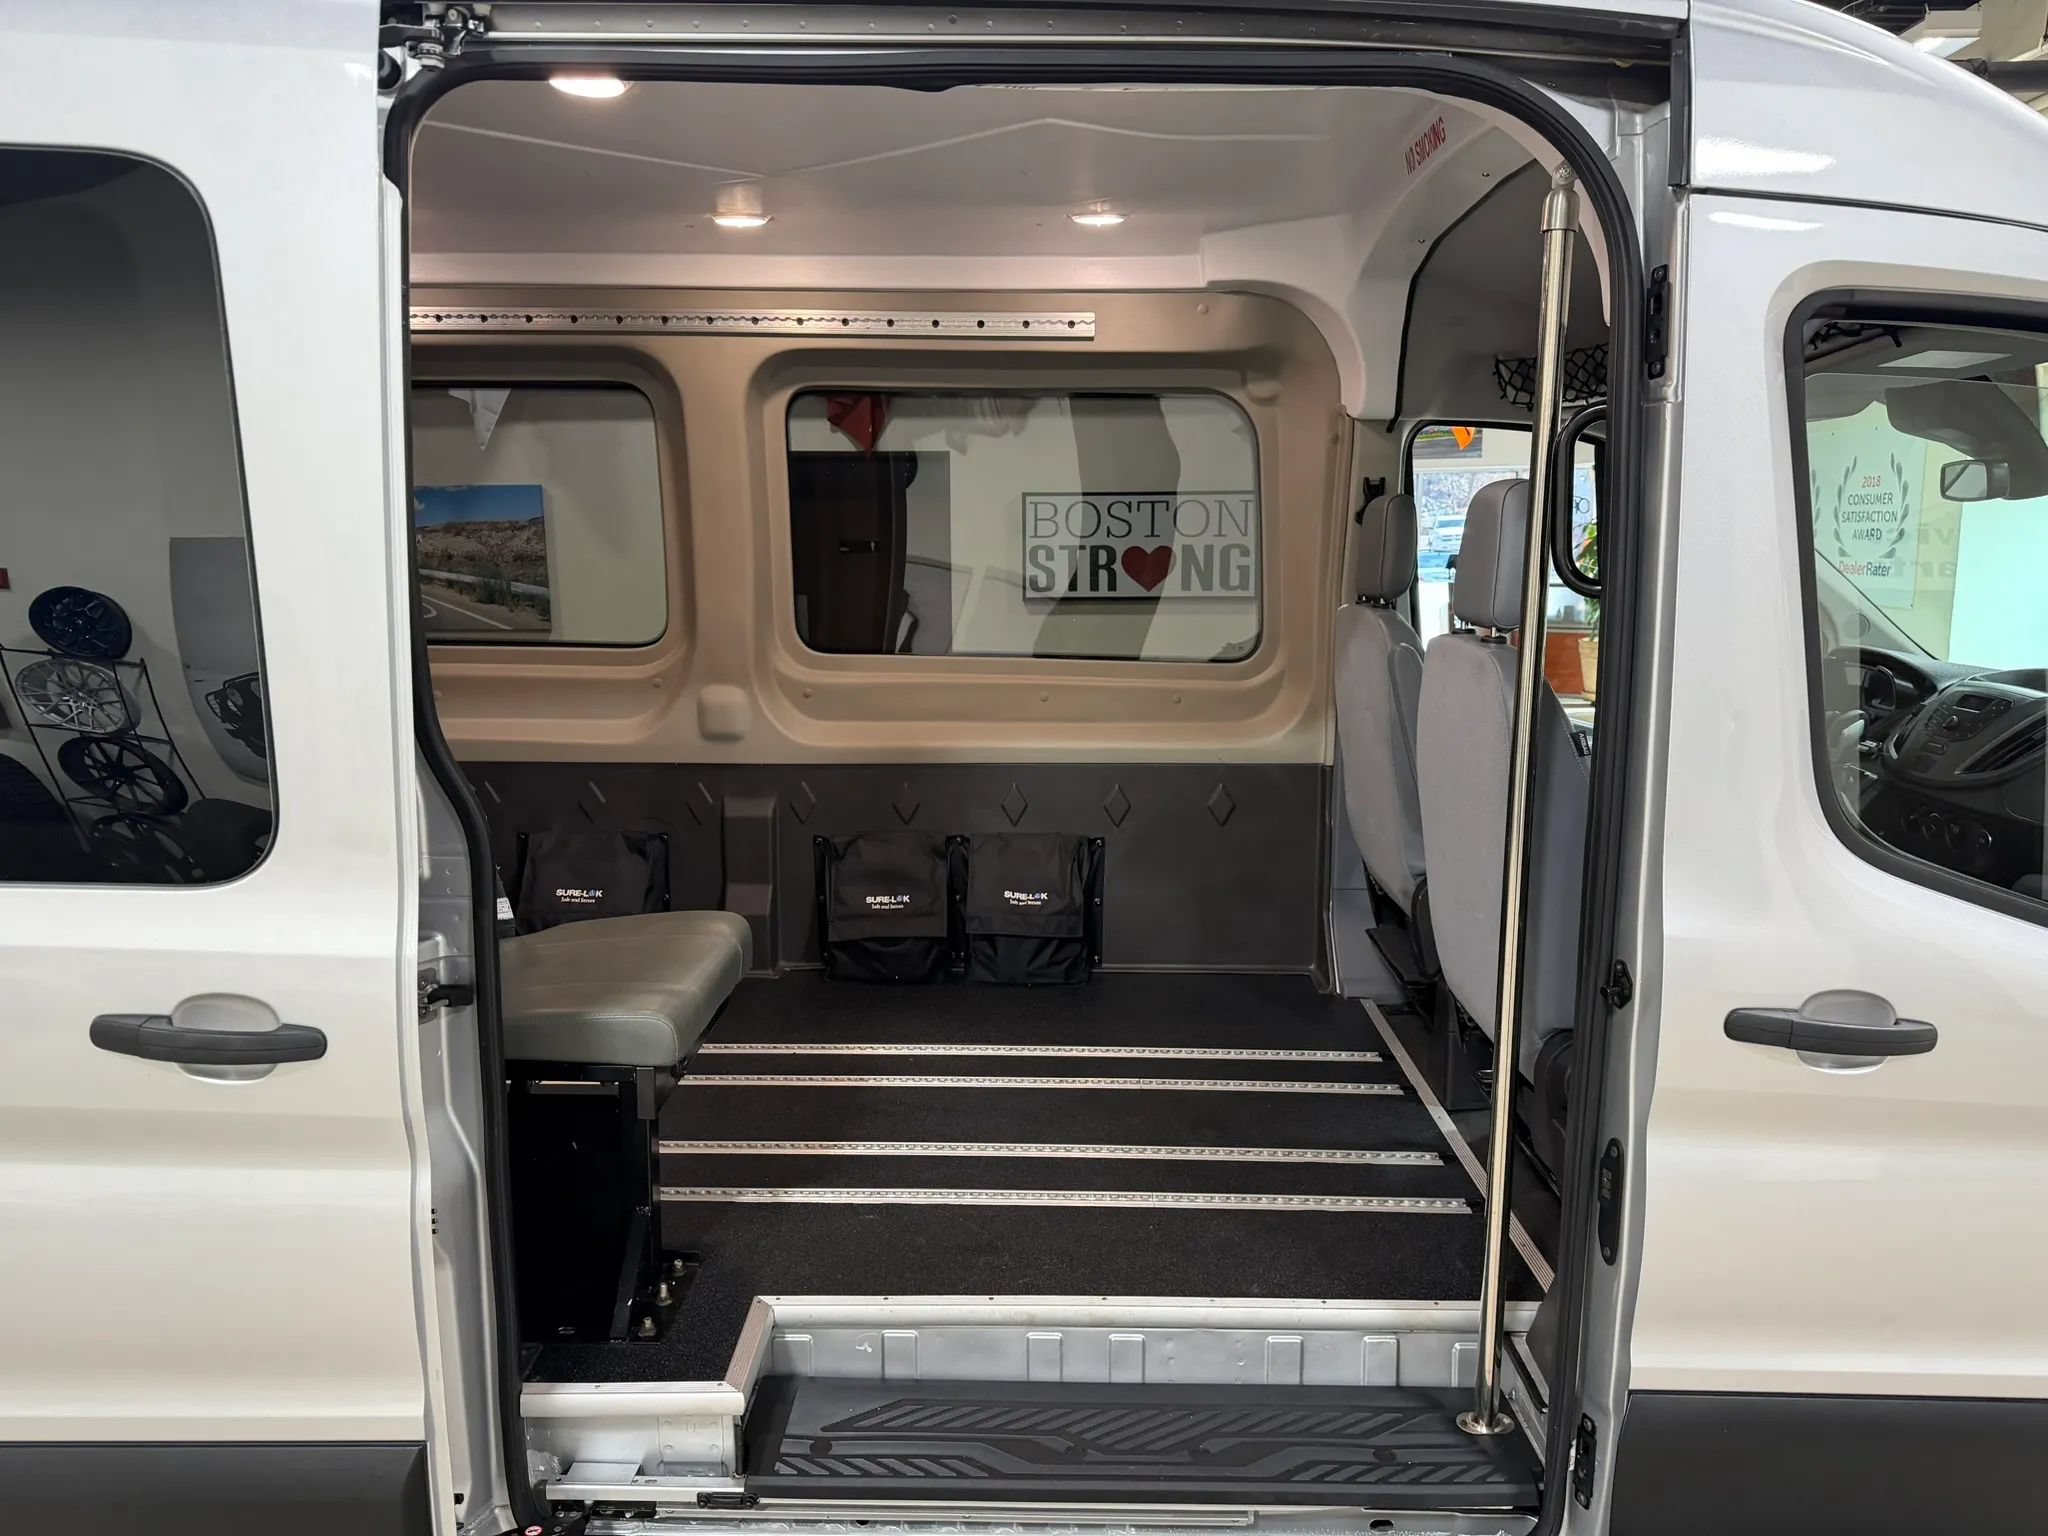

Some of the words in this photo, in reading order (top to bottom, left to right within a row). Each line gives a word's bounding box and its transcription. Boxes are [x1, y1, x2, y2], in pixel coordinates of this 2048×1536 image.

[1414, 115, 1447, 167] SMOKING
[1861, 475, 1881, 488] 2018
[1847, 491, 1894, 506] CONSUMER
[1028, 499, 1253, 539] BOSTON
[1841, 510, 1898, 523] SATISFACTION
[1851, 528, 1883, 541] AWARD
